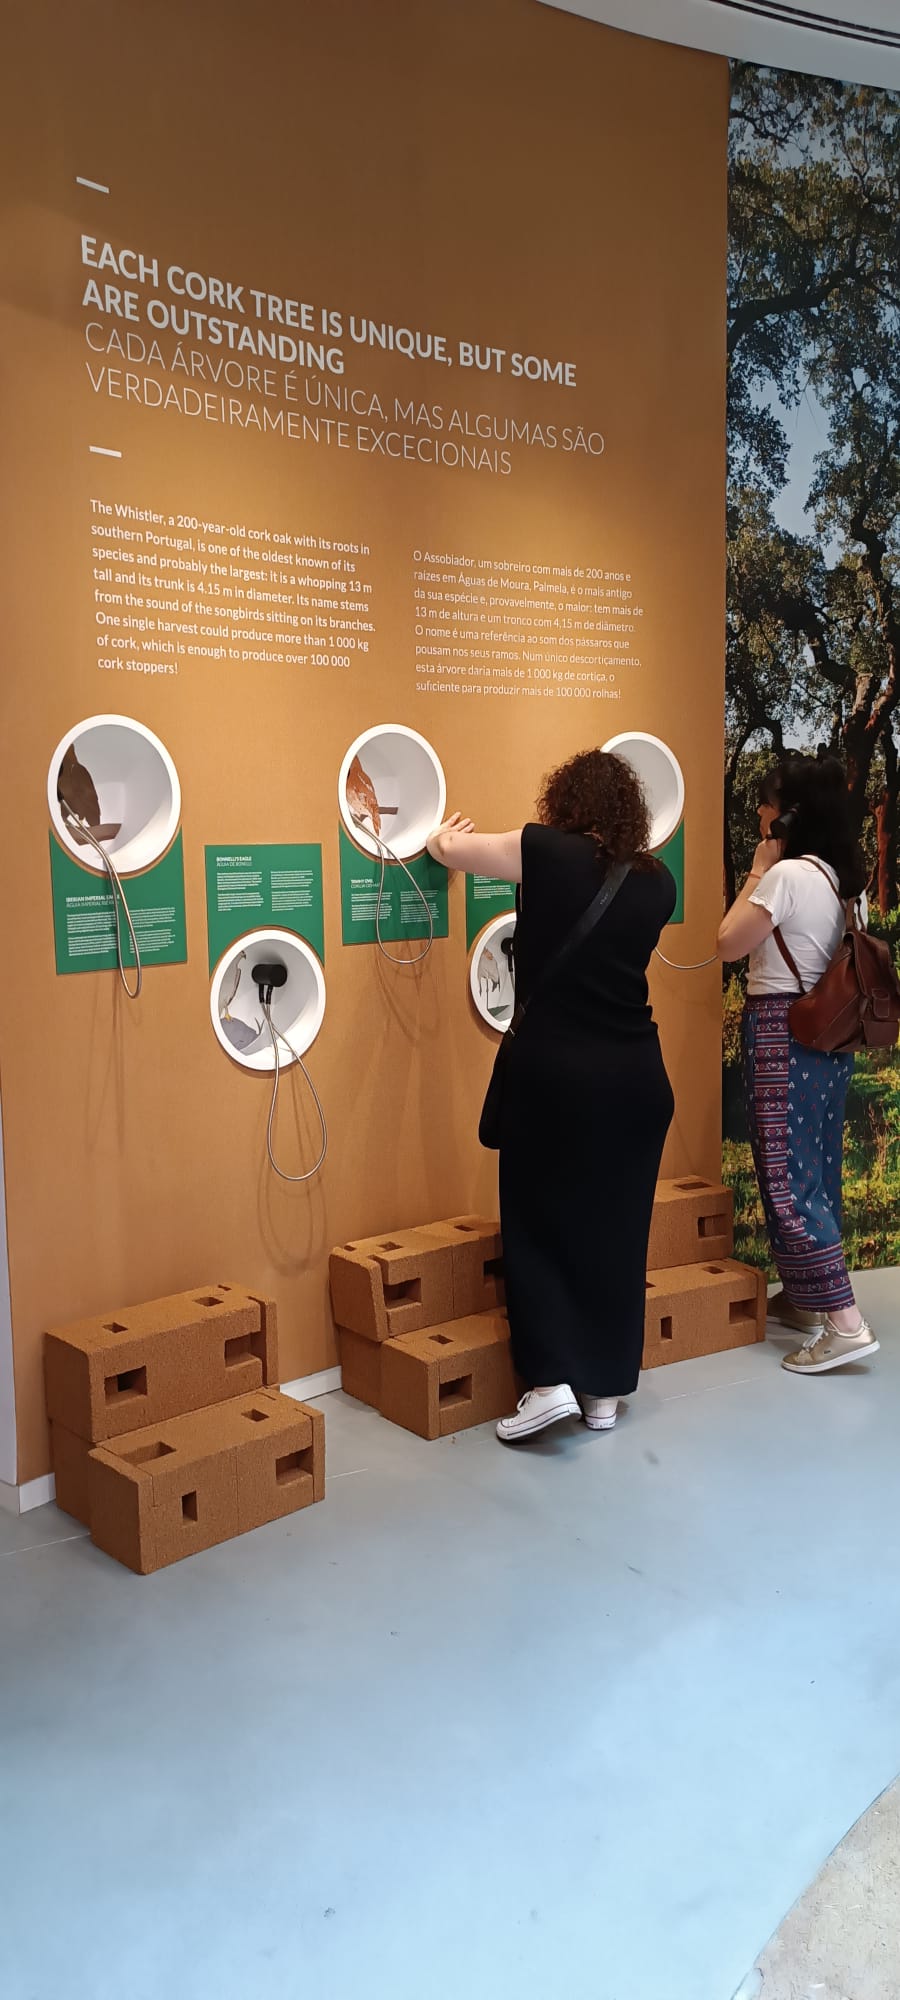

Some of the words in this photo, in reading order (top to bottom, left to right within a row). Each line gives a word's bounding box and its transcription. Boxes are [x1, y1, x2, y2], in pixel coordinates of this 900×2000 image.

[80, 234, 159, 287] EACH
[166, 265, 245, 313] CORK
[249, 289, 314, 331] TREE
[321, 308, 343, 337] IS
[348, 315, 453, 366] UNIQUE,
[458, 341, 506, 372] BUT
[510, 352, 577, 386] SOME
[82, 279, 139, 321] ARE
[146, 299, 344, 376] OUTSTANDING
[85, 322, 165, 369] CADA
[170, 342, 276, 396] ÁRVORE
[285, 370, 298, 401] É
[306, 375, 388, 423] ÚNICA,
[393, 398, 443, 429] MAS
[448, 409, 558, 448] ALGUMAS
[561, 425, 604, 454] SÃO
[84, 362, 350, 448] VERDADEIRAMENTE
[356, 425, 511, 474] EXCECIONAIS
[90, 499, 112, 515] The
[115, 503, 166, 525] Whistler,
[176, 515, 246, 537] 200-year-old
[247, 529, 271, 541] cork
[272, 532, 292, 544] oak
[293, 535, 316, 548] with
[318, 537, 330, 550] its
[332, 542, 358, 553] roots
[360, 543, 369, 555] in
[90, 525, 143, 542] southern
[197, 539, 206, 552] is
[208, 544, 227, 555] one
[229, 545, 240, 557] of
[242, 546, 259, 560] the
[261, 550, 293, 565] oldest
[295, 553, 329, 568] known
[331, 559, 342, 570] of
[343, 559, 356, 572] its
[92, 547, 134, 562] species
[136, 553, 156, 565] and
[159, 557, 208, 575] probably
[209, 562, 227, 575] the
[229, 564, 268, 581] largest:
[297, 575, 346, 592] whopping
[348, 580, 360, 592] 13
[93, 567, 112, 581] tall
[114, 571, 135, 584] and
[138, 572, 152, 586] its
[153, 575, 184, 591] trunk
[186, 579, 195, 592] is
[197, 581, 220, 595] 4.15
[234, 585, 244, 598] in
[246, 587, 294, 604] diameter.
[296, 593, 309, 606] Its
[311, 597, 338, 609] name
[340, 599, 368, 612] stems
[94, 588, 122, 604] from
[124, 592, 143, 607] the
[145, 598, 178, 611] sound
[181, 600, 193, 612] of
[194, 602, 212, 615] the
[214, 607, 264, 621] songbirds
[266, 610, 298, 627] sitting
[300, 616, 313, 626] on
[314, 615, 327, 627] its
[329, 616, 376, 631] branches.
[95, 611, 120, 626] One
[122, 615, 155, 631] single
[157, 617, 198, 634] harvest
[200, 624, 228, 637] could
[230, 628, 273, 641] produce
[275, 633, 301, 644] more
[303, 633, 326, 646] than
[357, 638, 369, 652] kg
[96, 634, 108, 646] of
[141, 639, 175, 653] which
[177, 641, 186, 654] is
[187, 645, 226, 659] enough
[228, 647, 240, 658] to
[241, 649, 284, 662] produce
[285, 654, 308, 664] over
[97, 656, 124, 669] cork
[125, 659, 178, 674] stoppers!
